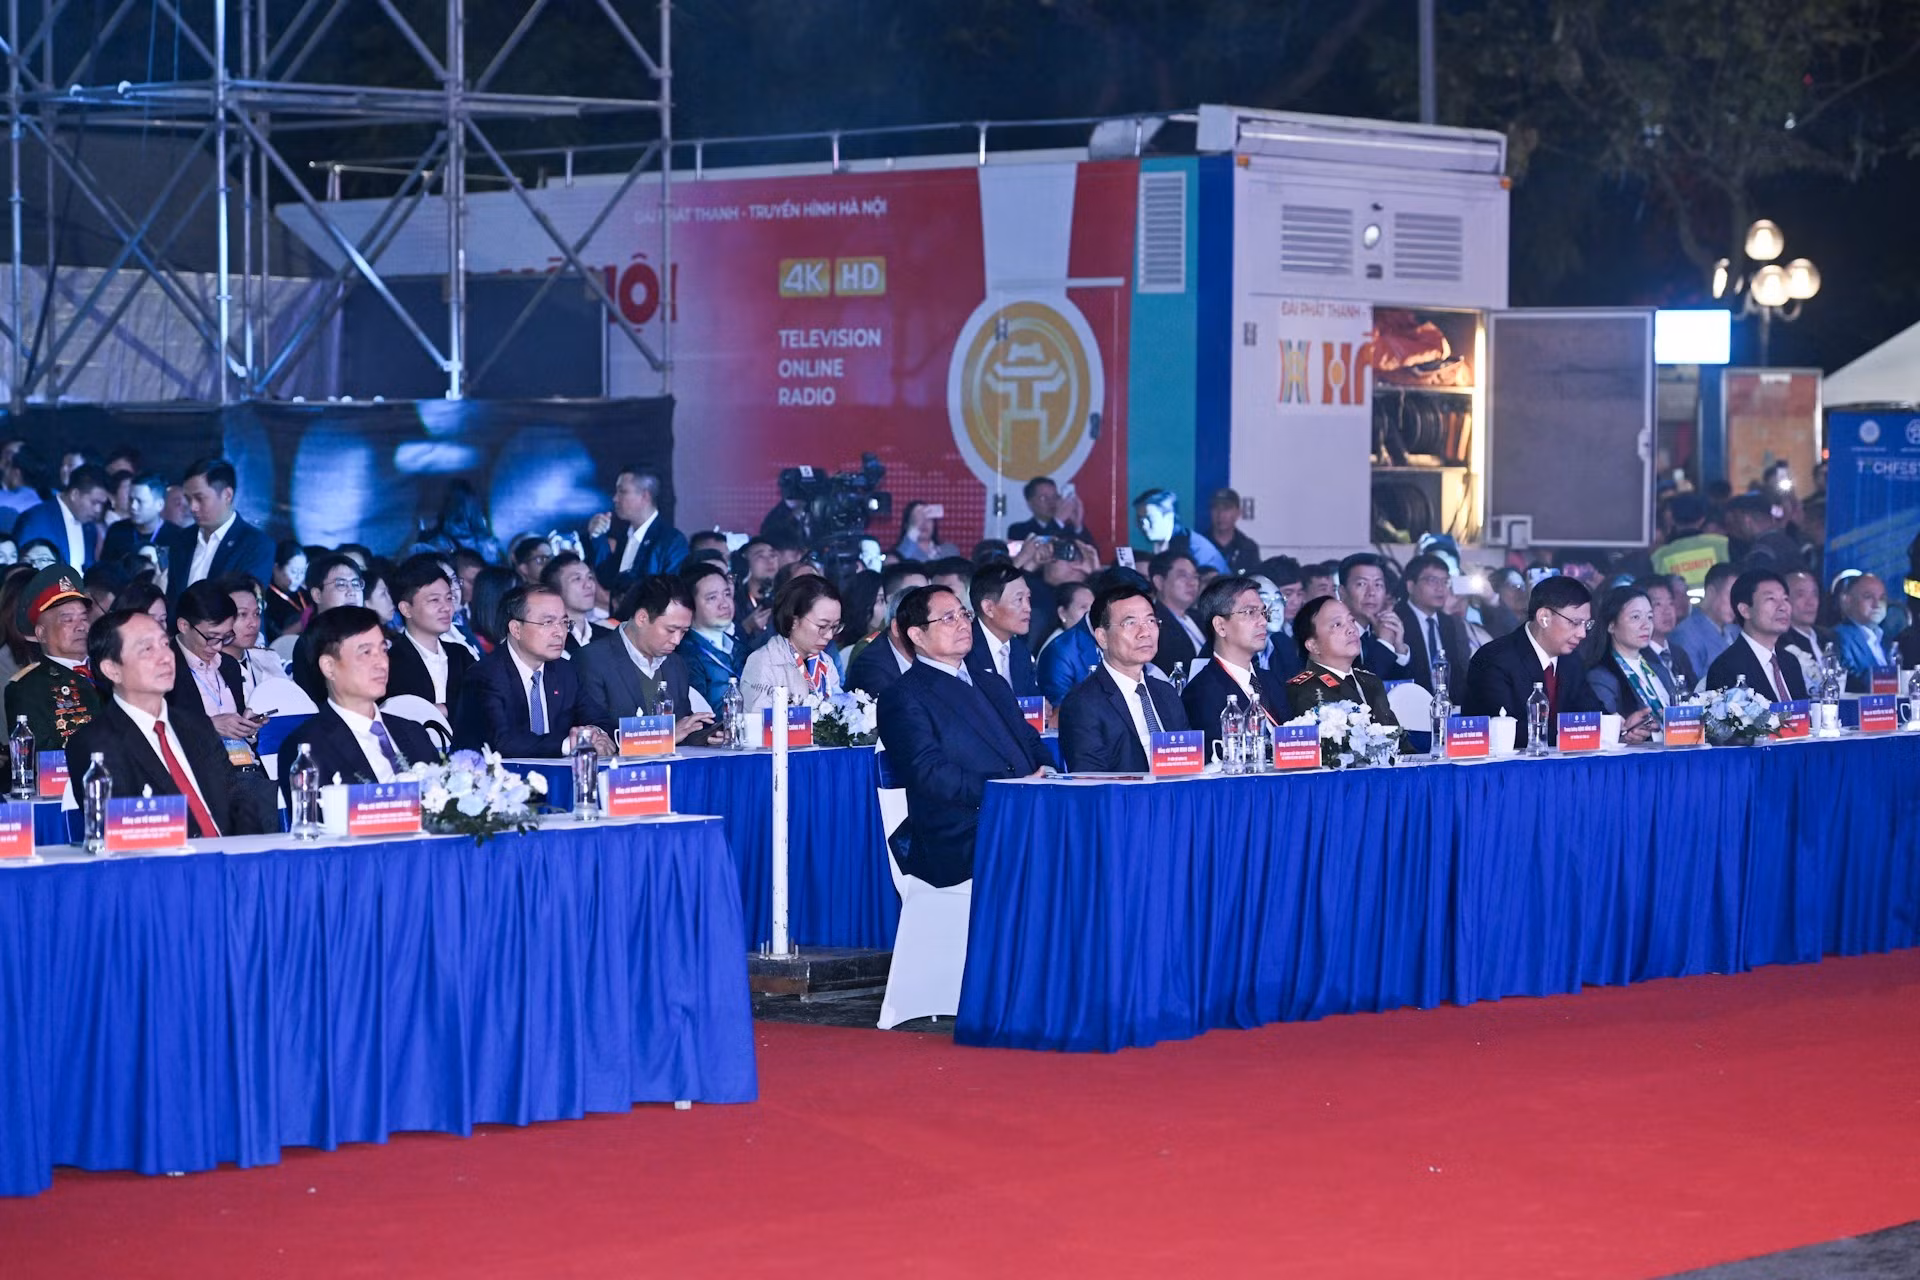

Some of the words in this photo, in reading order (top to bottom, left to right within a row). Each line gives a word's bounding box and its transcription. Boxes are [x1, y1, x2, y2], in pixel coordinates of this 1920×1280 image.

[693, 206, 739, 222] THANH
[748, 198, 801, 220] TRUYỀN
[803, 198, 838, 218] HÌNH
[839, 196, 859, 216] HÀ
[861, 195, 887, 219] NỘI
[783, 261, 824, 292] 4K
[841, 261, 880, 291] HD
[778, 328, 882, 348] TELEVISION
[778, 358, 844, 378] ONLINE
[778, 386, 836, 407] RADIO
